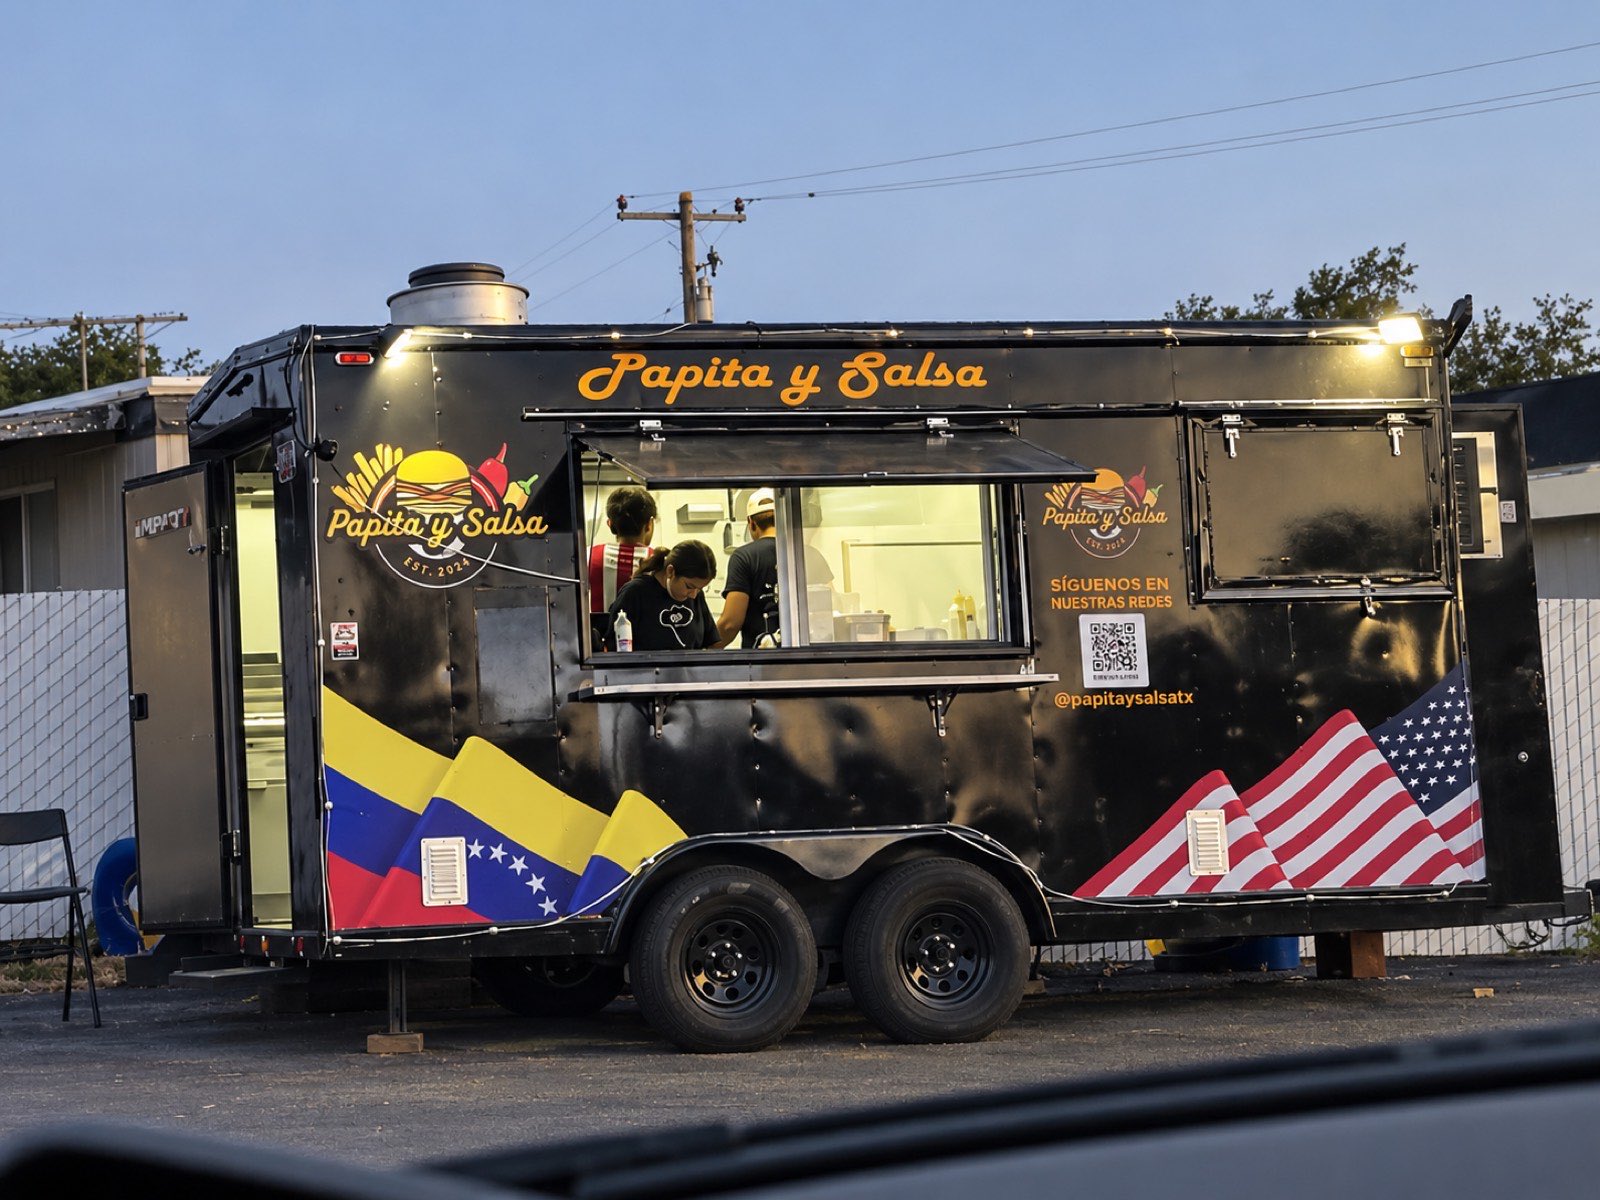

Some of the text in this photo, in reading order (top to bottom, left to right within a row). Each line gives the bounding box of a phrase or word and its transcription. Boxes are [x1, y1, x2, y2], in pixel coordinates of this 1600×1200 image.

[578, 351, 988, 406] Papita y Salsa
[326, 508, 549, 548] Papita y Salsa
[1042, 505, 1168, 532] Papita y Salsa
[403, 556, 471, 577] EST. 2024
[1051, 575, 1169, 592] SÍGUENOS EN
[1051, 595, 1173, 609] NUESTRAS REDES
[1054, 690, 1194, 709] @papitaysalsatx
